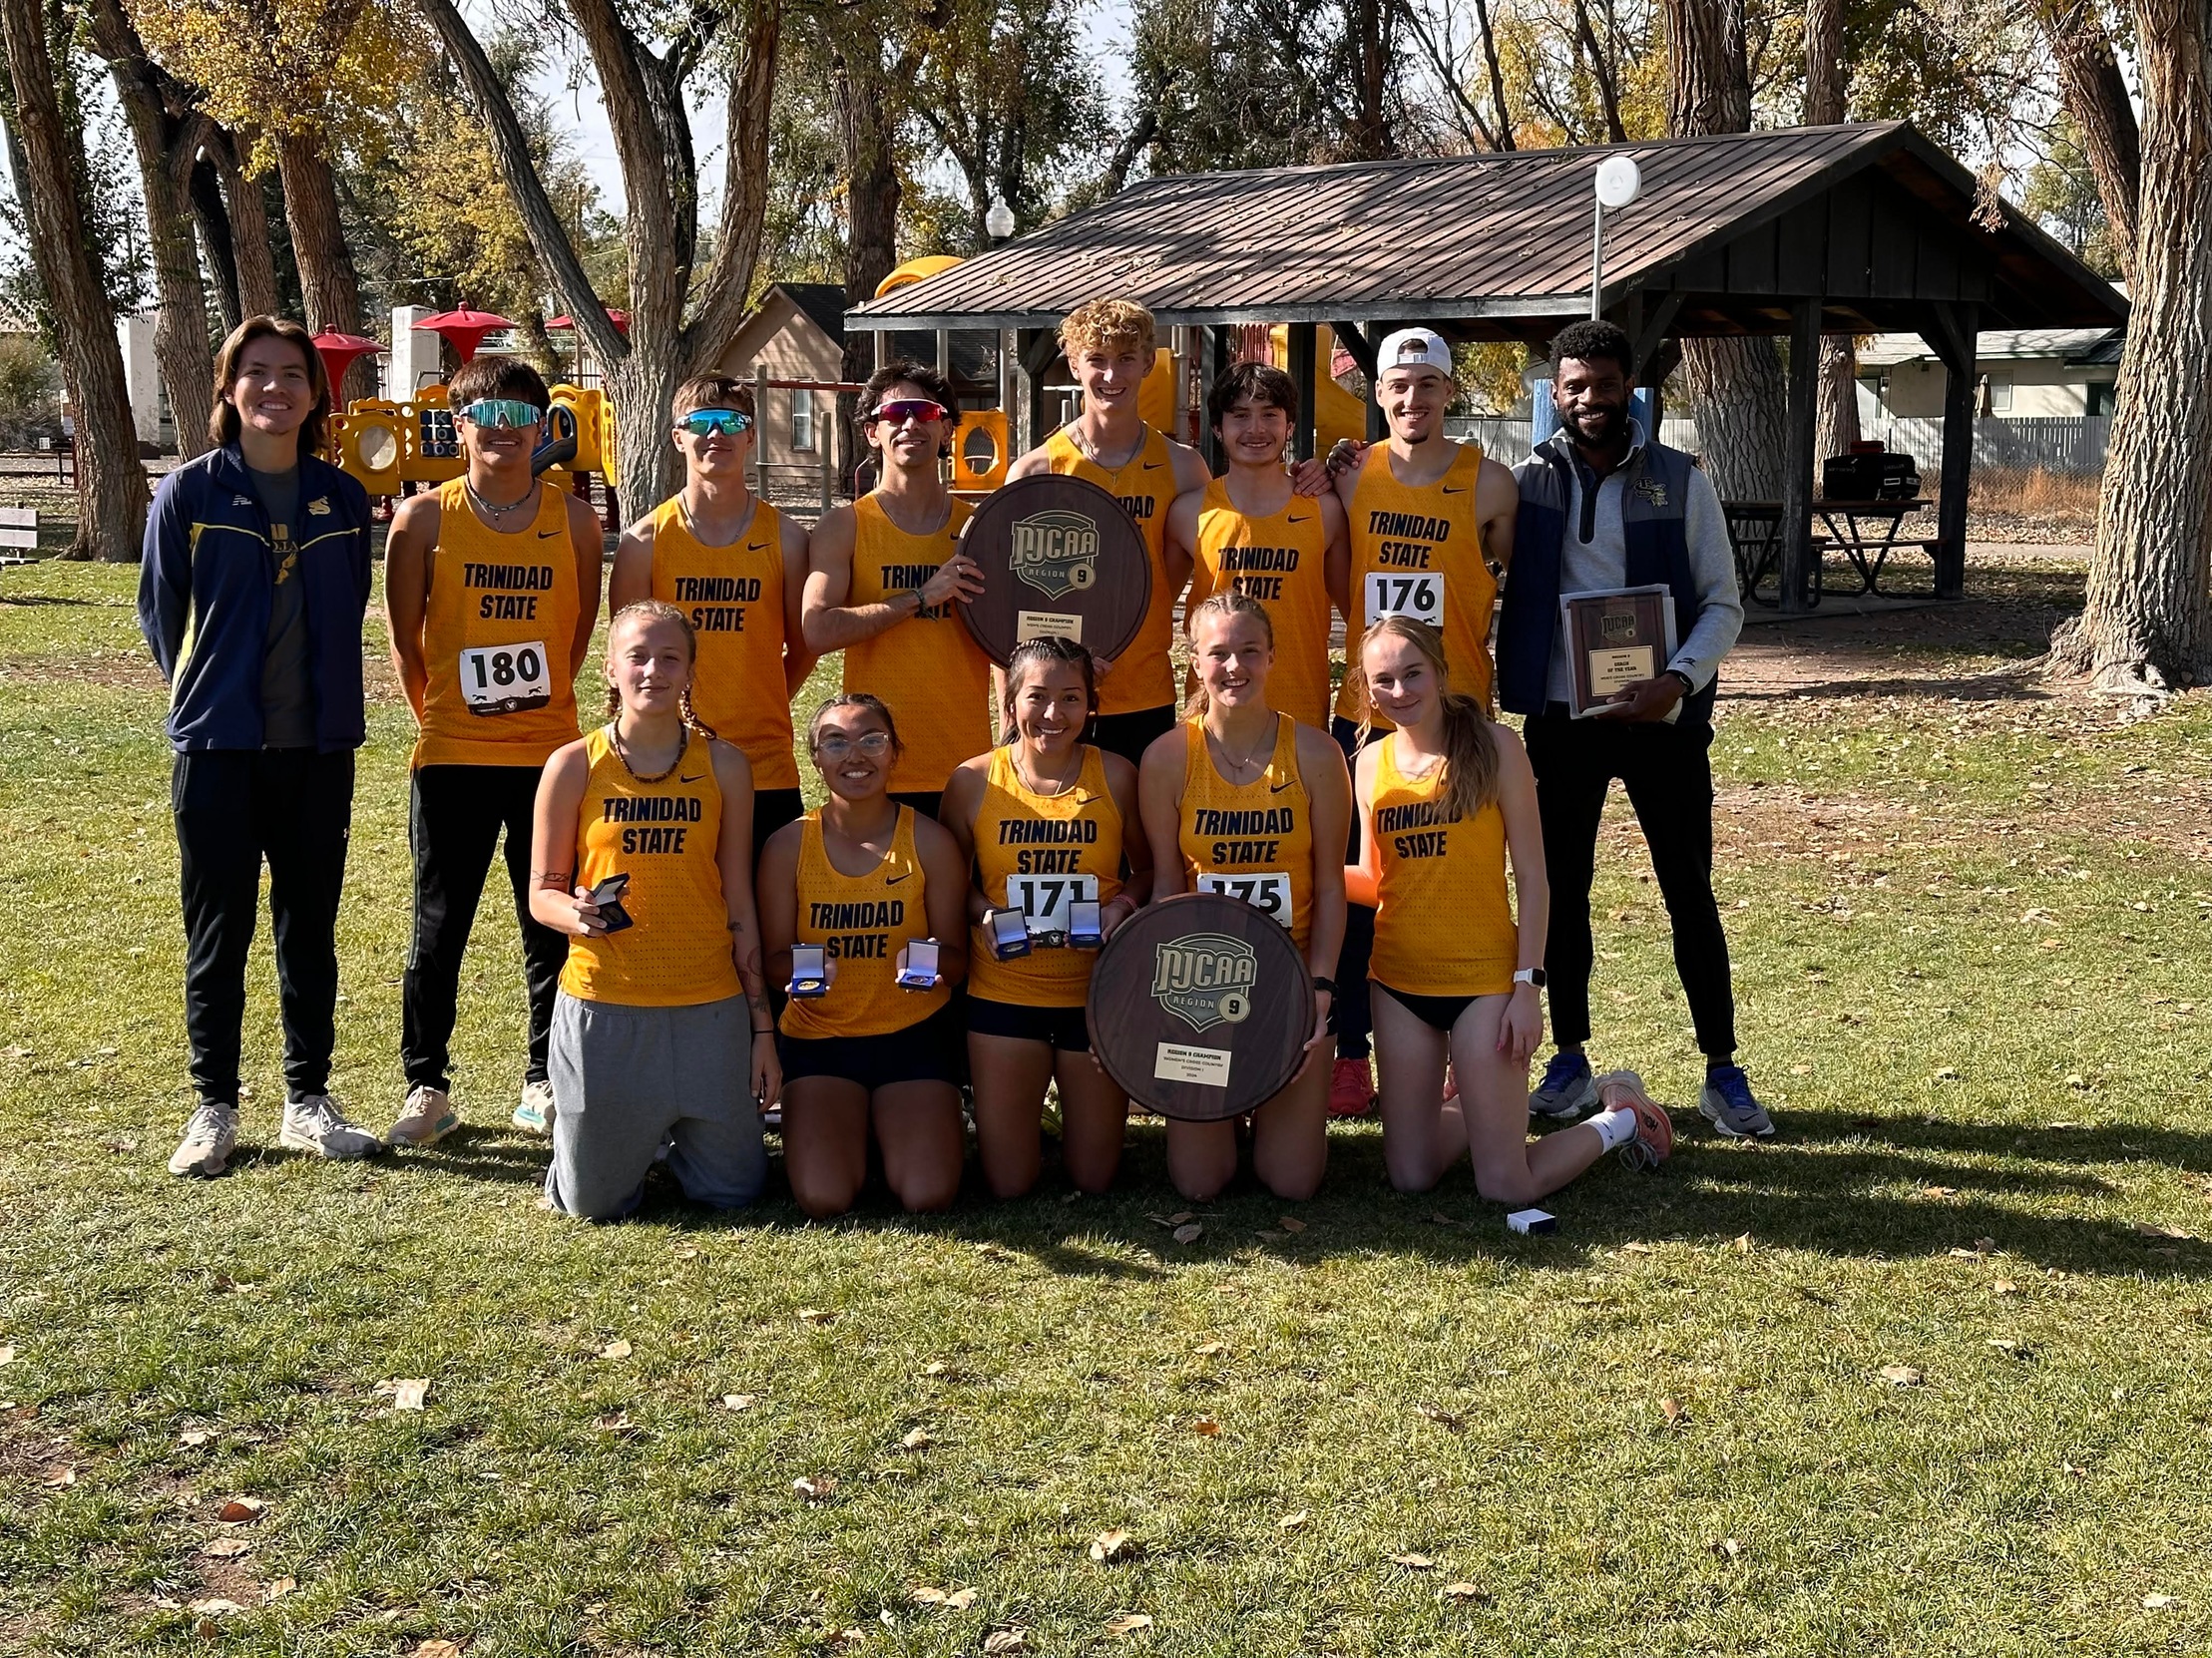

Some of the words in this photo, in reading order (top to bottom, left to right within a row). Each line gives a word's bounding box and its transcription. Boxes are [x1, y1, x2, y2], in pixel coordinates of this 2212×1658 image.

[1368, 511, 1451, 542] TRINIDAD
[1014, 526, 1096, 565] NJCAA
[1379, 541, 1432, 569] STATE
[1218, 547, 1299, 572] TRINIDAD
[464, 564, 553, 591] TRINIDAD
[881, 565, 941, 590] TRINI
[1029, 569, 1065, 579] REGION
[1078, 570, 1087, 583] 9
[1232, 576, 1283, 600] STATE
[675, 578, 761, 602] TRINIDAD
[1377, 579, 1435, 611] 176
[480, 595, 538, 621] STATE
[691, 608, 745, 631] STATE
[471, 648, 541, 688] 180
[604, 797, 701, 823] TRINIDAD
[1194, 807, 1294, 835] TRINIDAD
[623, 828, 687, 854] STATE
[999, 820, 1097, 845] TRINIDAD
[1395, 831, 1447, 859] STATE
[1018, 850, 1082, 874] STATE
[1212, 841, 1279, 865] STATE
[1021, 881, 1084, 917] 171
[810, 900, 904, 929] TRINIDAD
[827, 934, 889, 958] STATE
[1157, 949, 1252, 991] NJCAA
[1173, 996, 1214, 1009] REGION
[1228, 1000, 1240, 1015] 9
